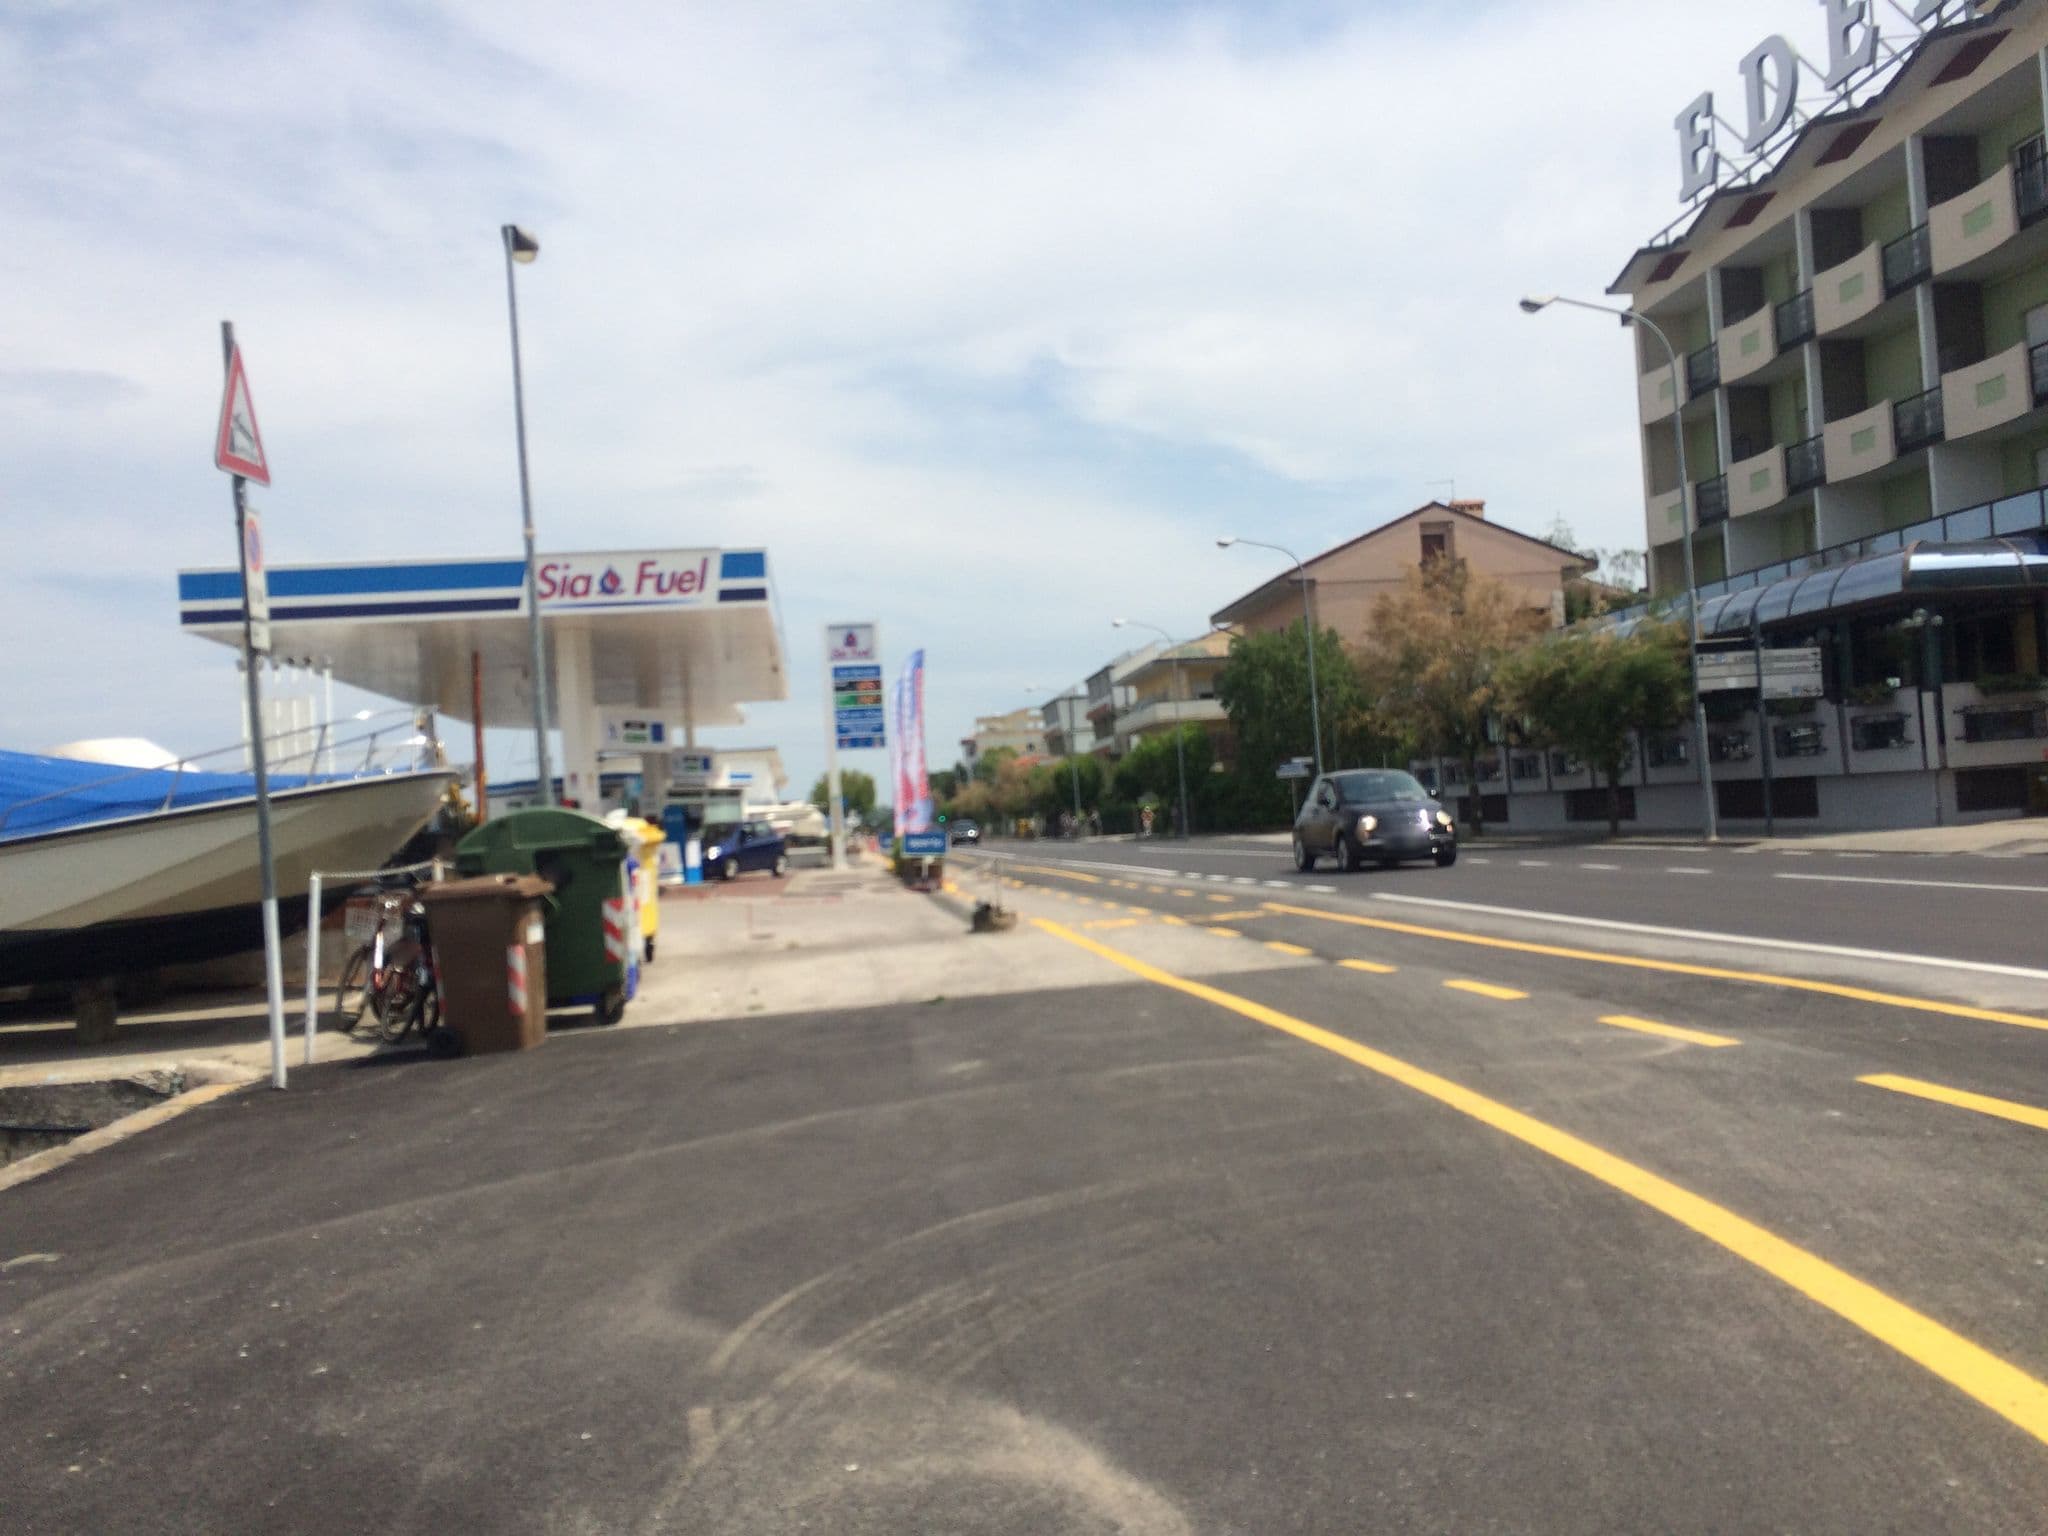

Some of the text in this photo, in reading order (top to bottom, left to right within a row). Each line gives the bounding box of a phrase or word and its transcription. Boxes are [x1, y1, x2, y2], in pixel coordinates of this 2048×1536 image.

[1674, 0, 1946, 203] EDE
[538, 557, 709, 600] Sia Fuel
